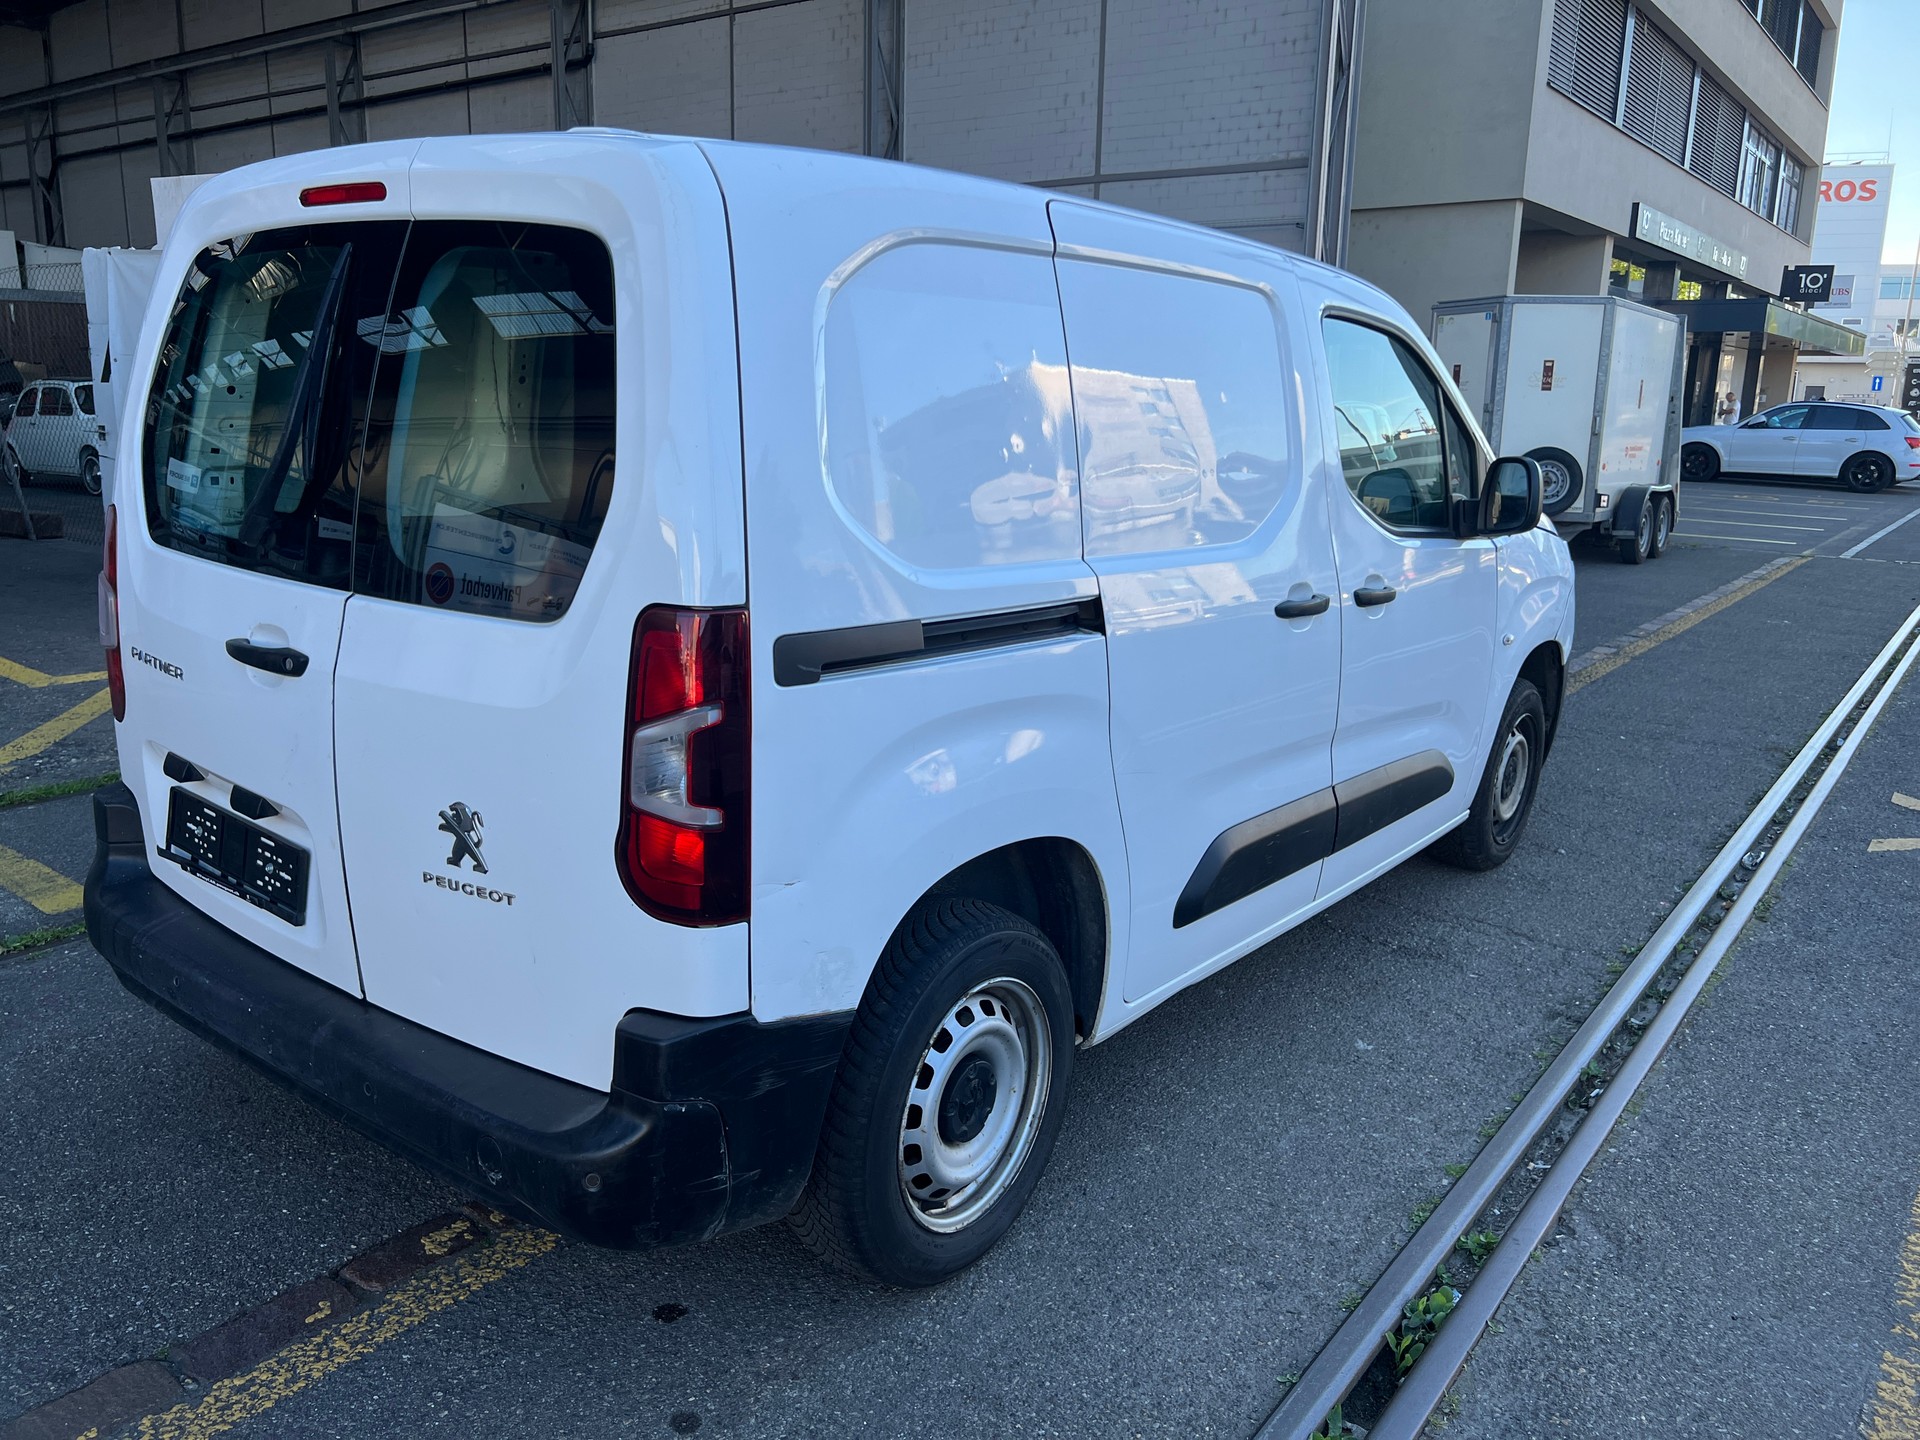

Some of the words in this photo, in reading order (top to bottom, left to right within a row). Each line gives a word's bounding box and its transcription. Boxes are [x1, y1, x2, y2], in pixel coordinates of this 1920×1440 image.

[1819, 179, 1878, 202] ROS
[1831, 287, 1850, 296] UBS
[131, 646, 184, 681] PARTNER
[422, 871, 516, 906] PEUGEOT
